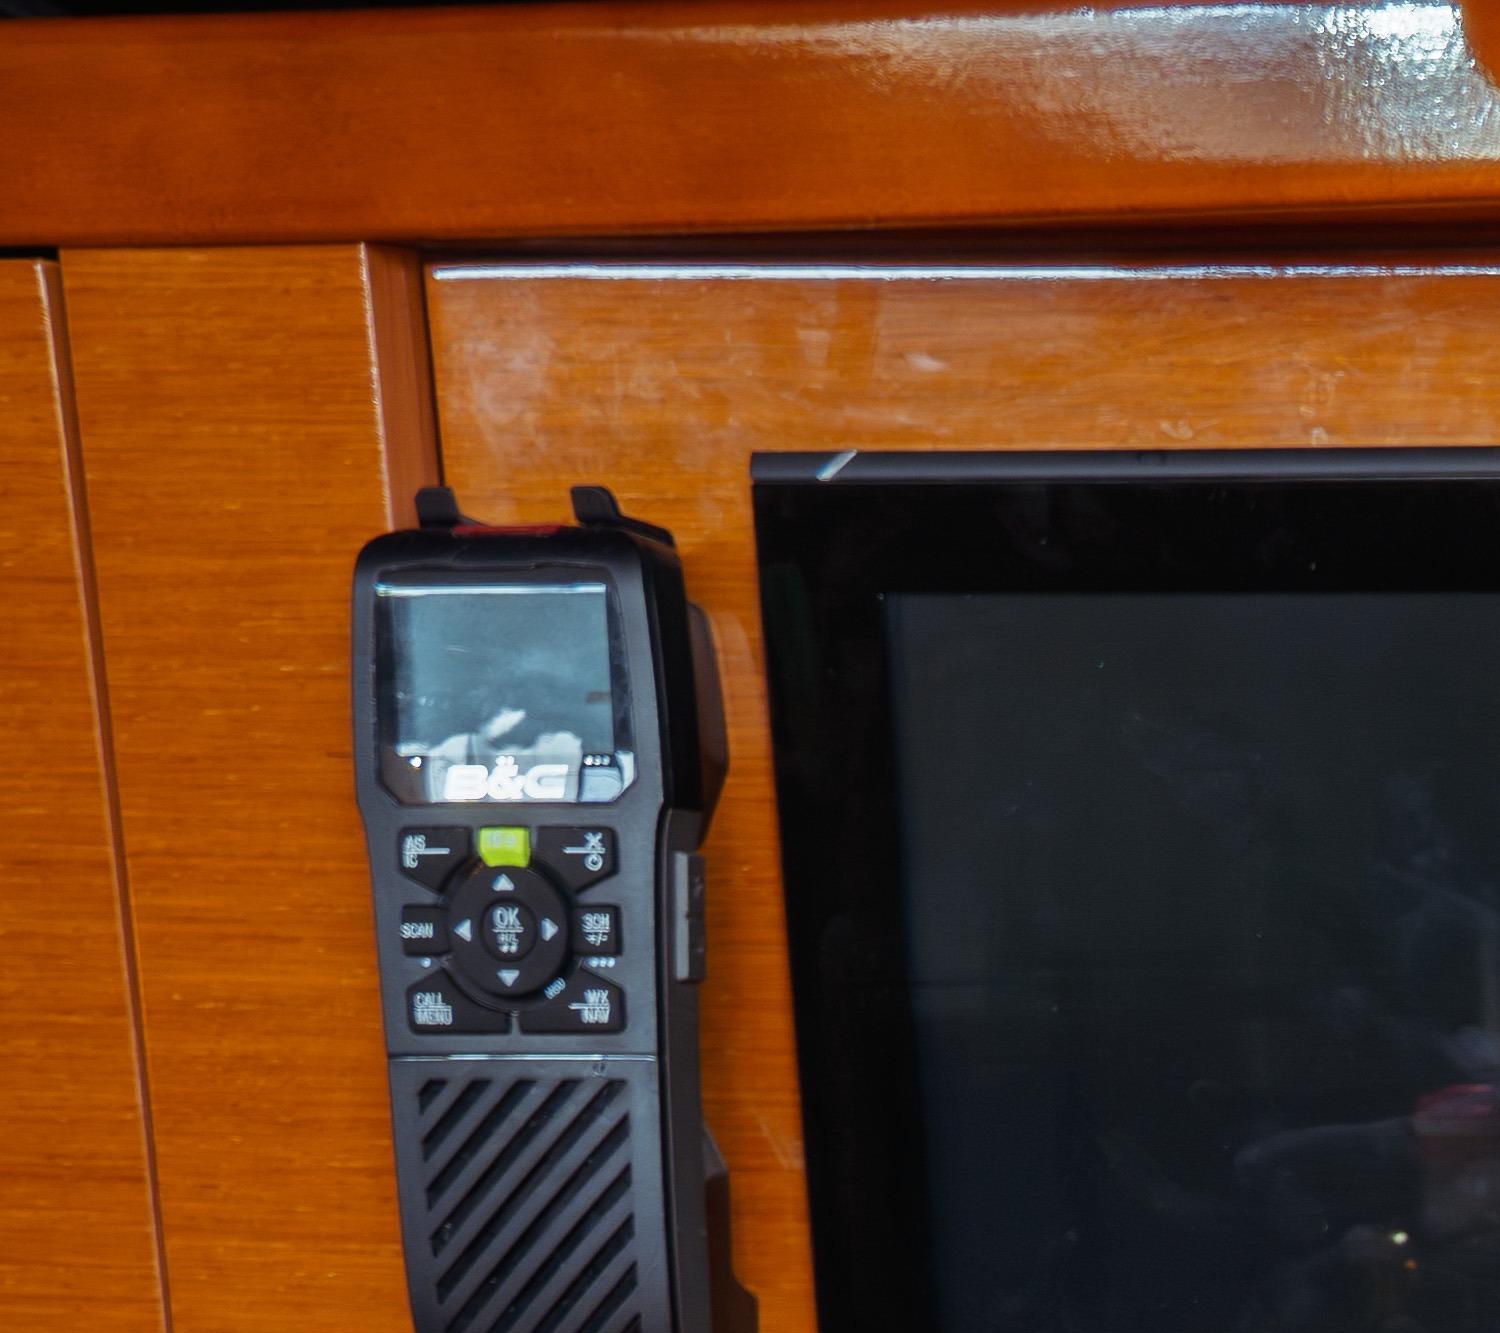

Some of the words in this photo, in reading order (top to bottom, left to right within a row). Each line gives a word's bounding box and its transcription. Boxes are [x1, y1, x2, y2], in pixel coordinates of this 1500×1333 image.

[444, 764, 569, 800] B&G
[493, 907, 521, 927] OK
[400, 922, 434, 939] SCAN
[414, 992, 447, 1005] CALL
[415, 1008, 452, 1025] MENU
